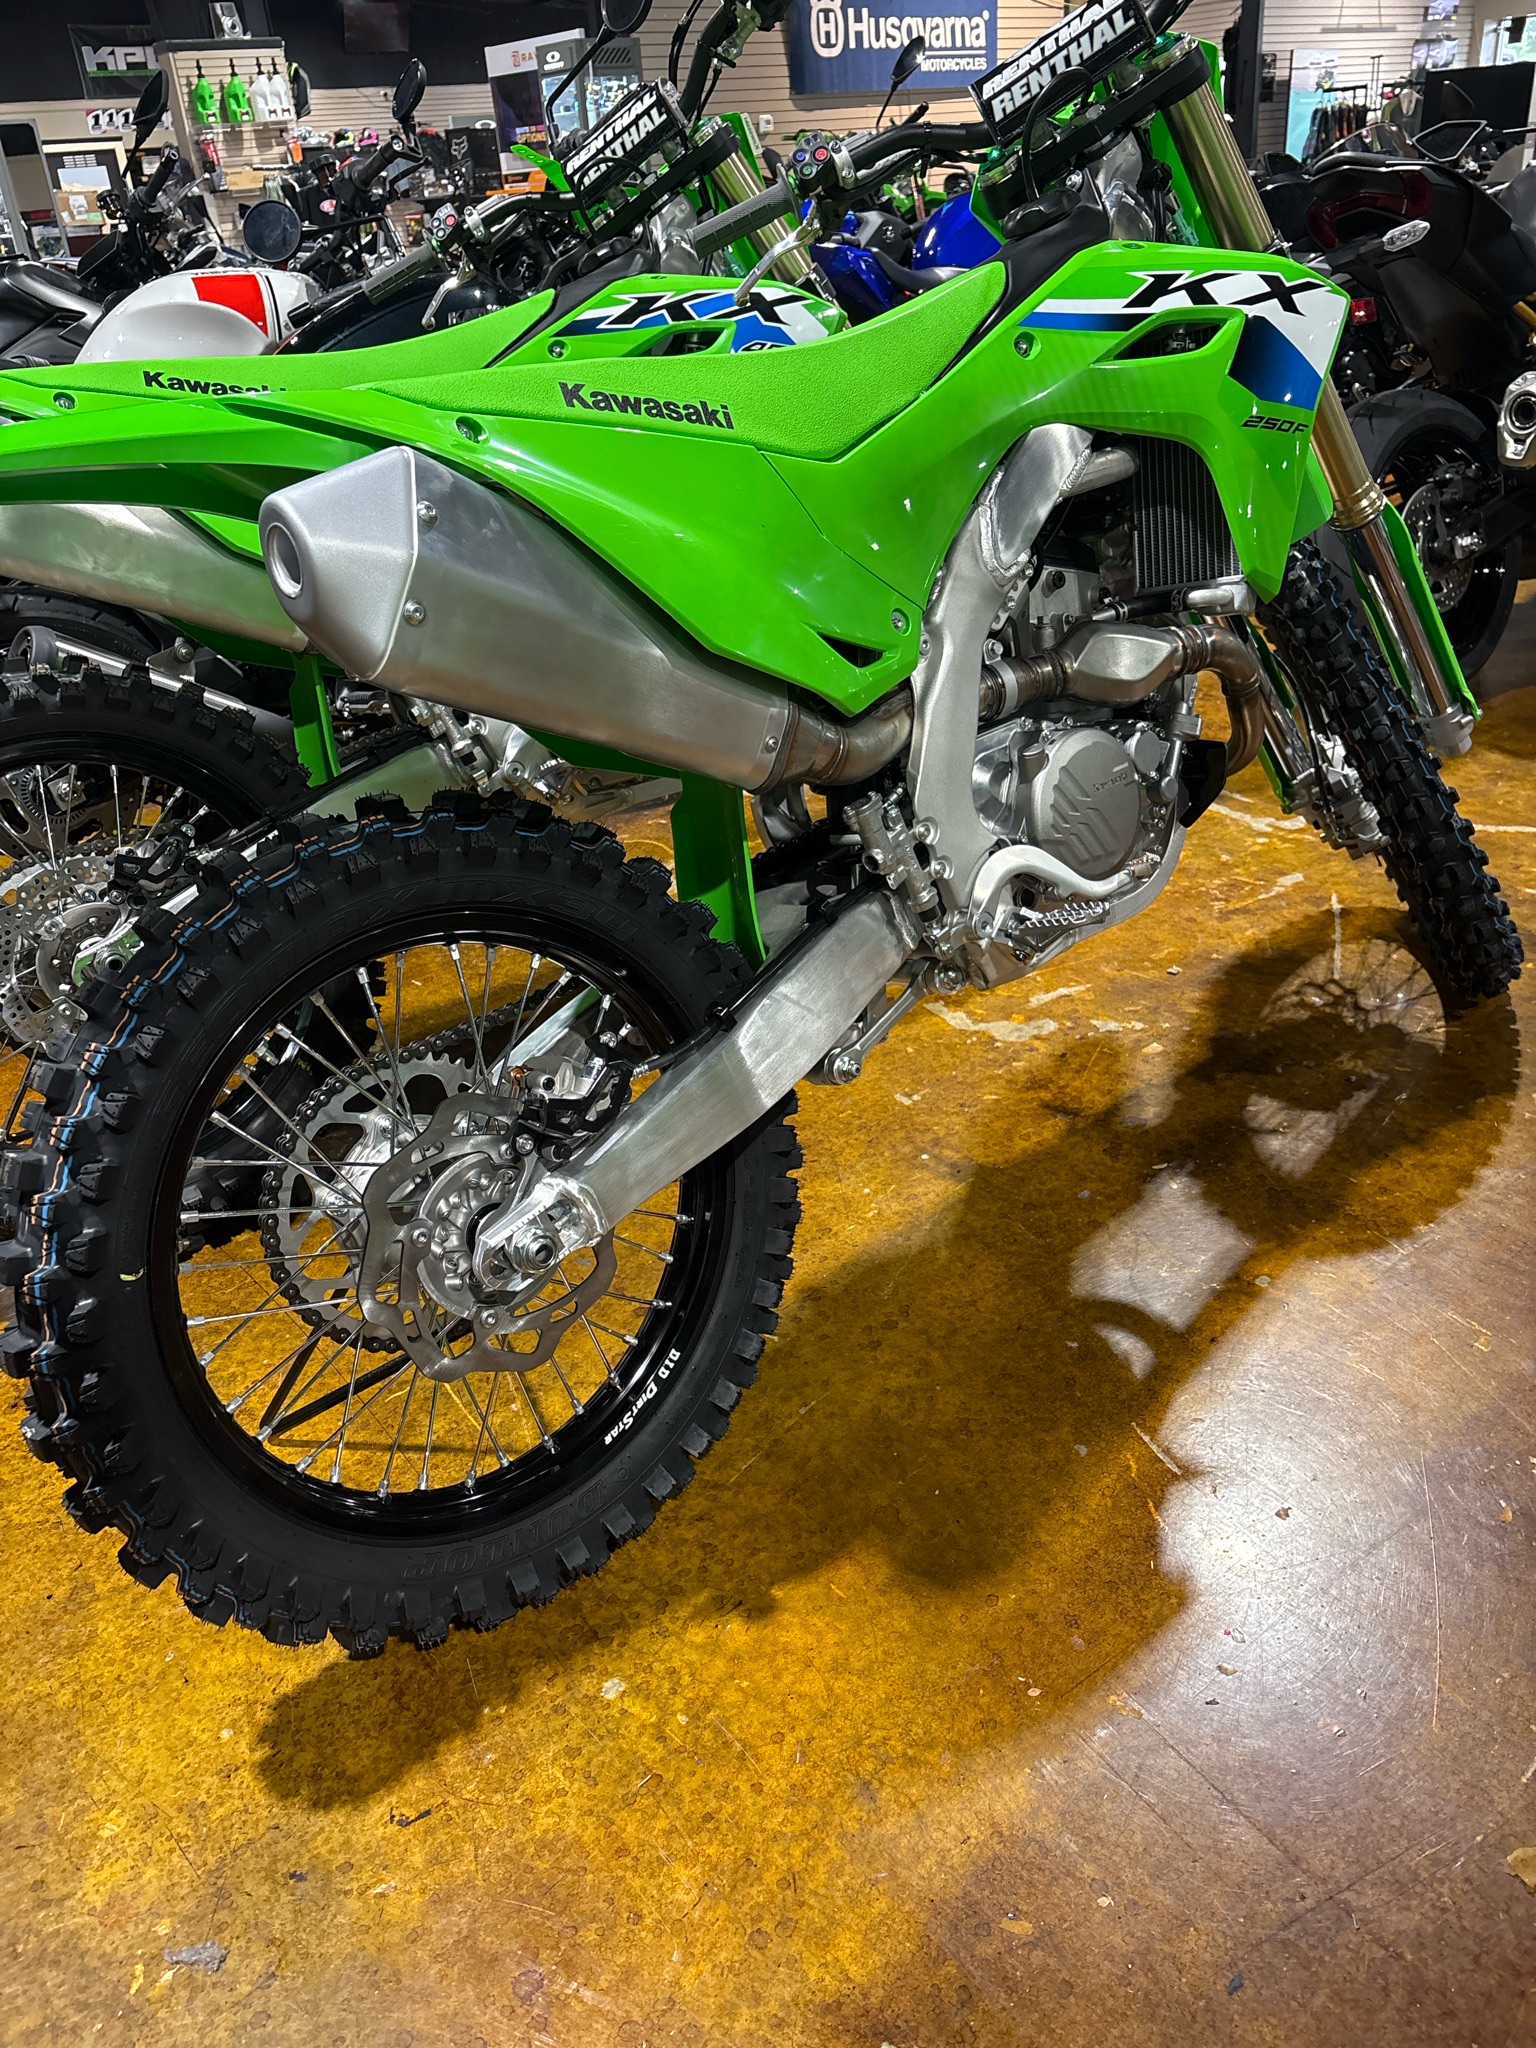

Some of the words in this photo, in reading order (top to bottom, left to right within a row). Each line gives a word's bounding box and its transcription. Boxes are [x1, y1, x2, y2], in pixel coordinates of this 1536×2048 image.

[847, 7, 986, 49] Husqvarna
[920, 57, 987, 72] MOTORCYCLES
[991, 8, 1136, 122] RENTHAL
[604, 291, 811, 326] KX
[1122, 272, 1328, 317] KX
[142, 370, 287, 396] Kawas
[558, 381, 734, 430] Kawasaki
[1241, 414, 1309, 435] 250F
